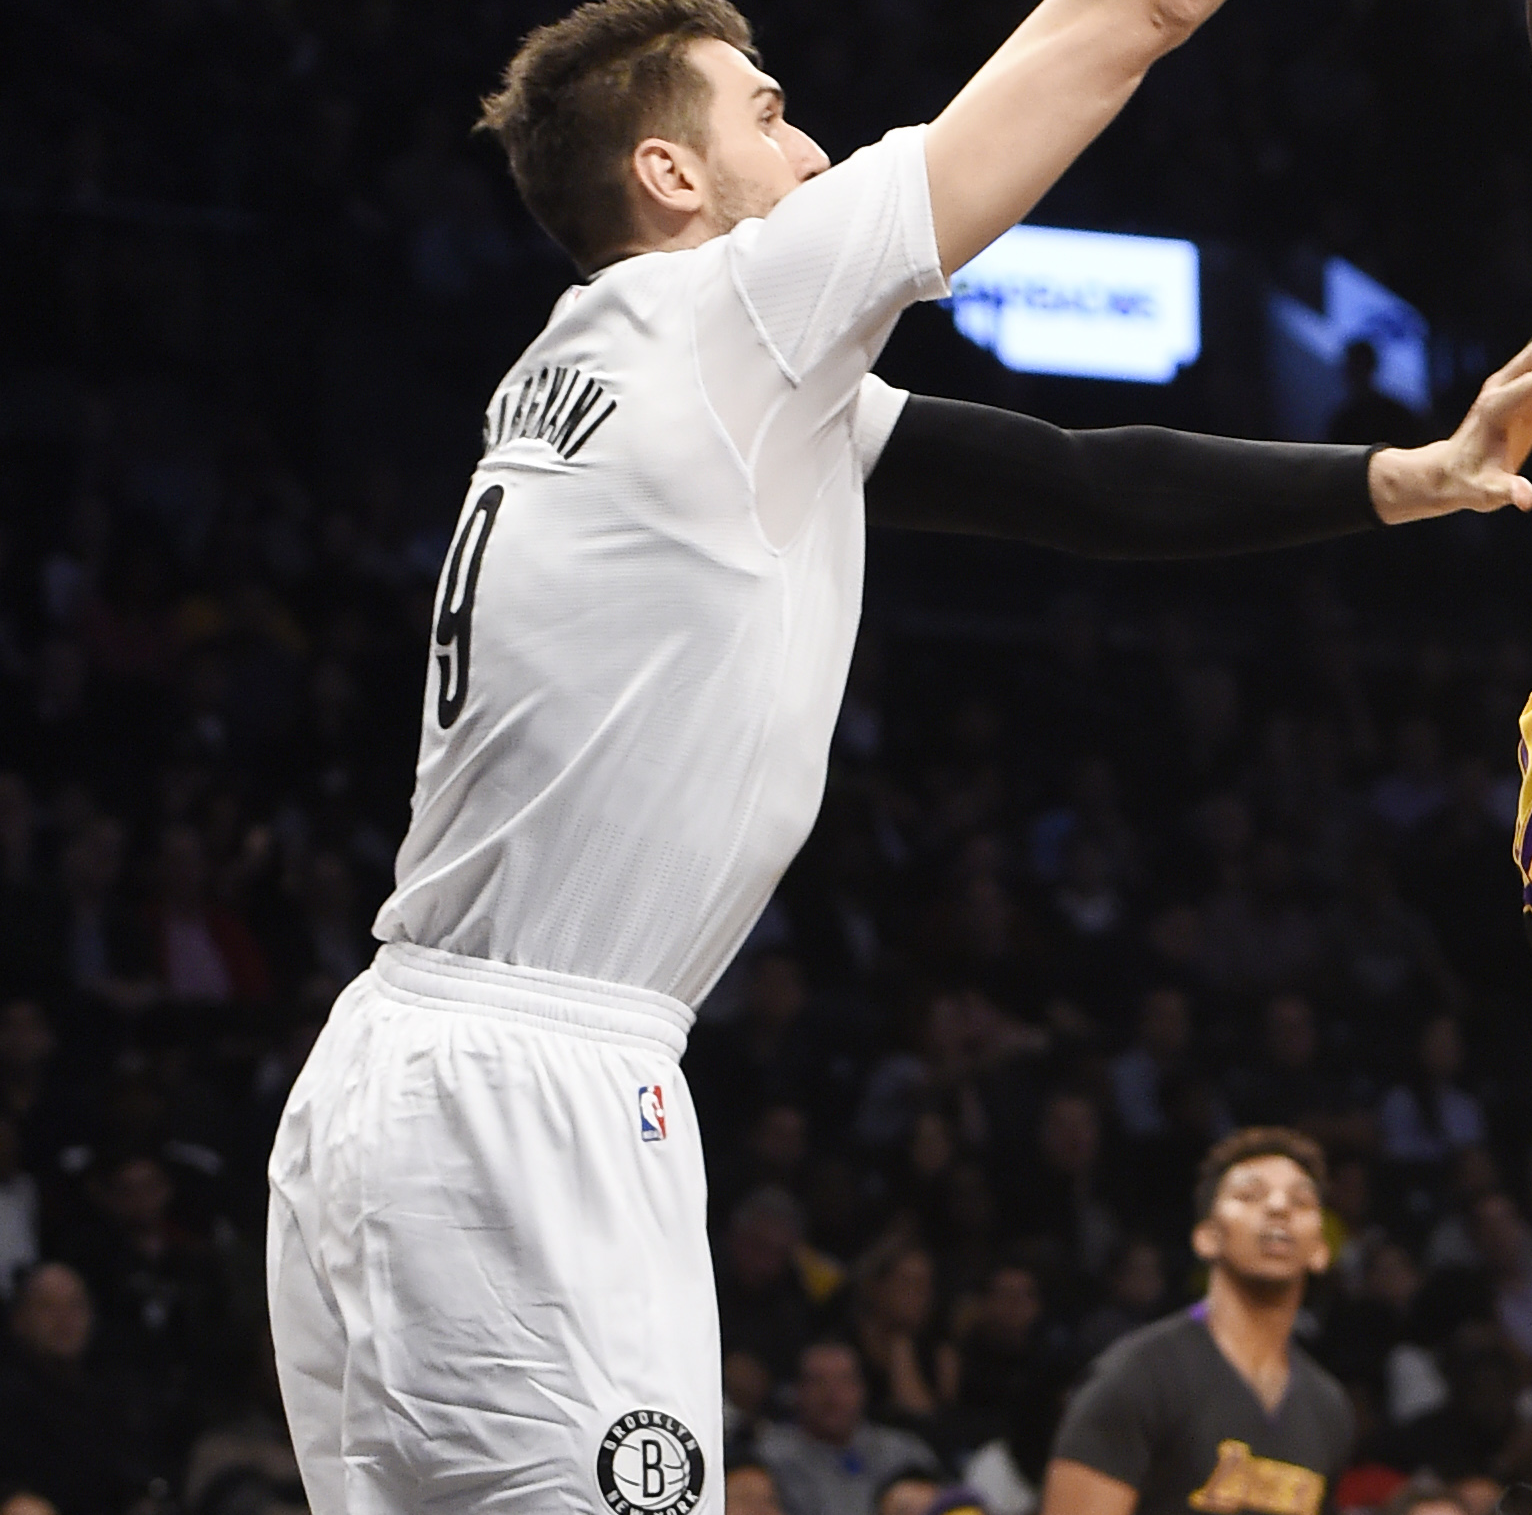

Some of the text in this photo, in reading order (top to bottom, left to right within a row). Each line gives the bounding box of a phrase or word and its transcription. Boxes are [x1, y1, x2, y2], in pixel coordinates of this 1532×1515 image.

[436, 485, 504, 730] 9
[603, 1411, 698, 1451] BROOKLYN
[641, 1439, 665, 1498] B
